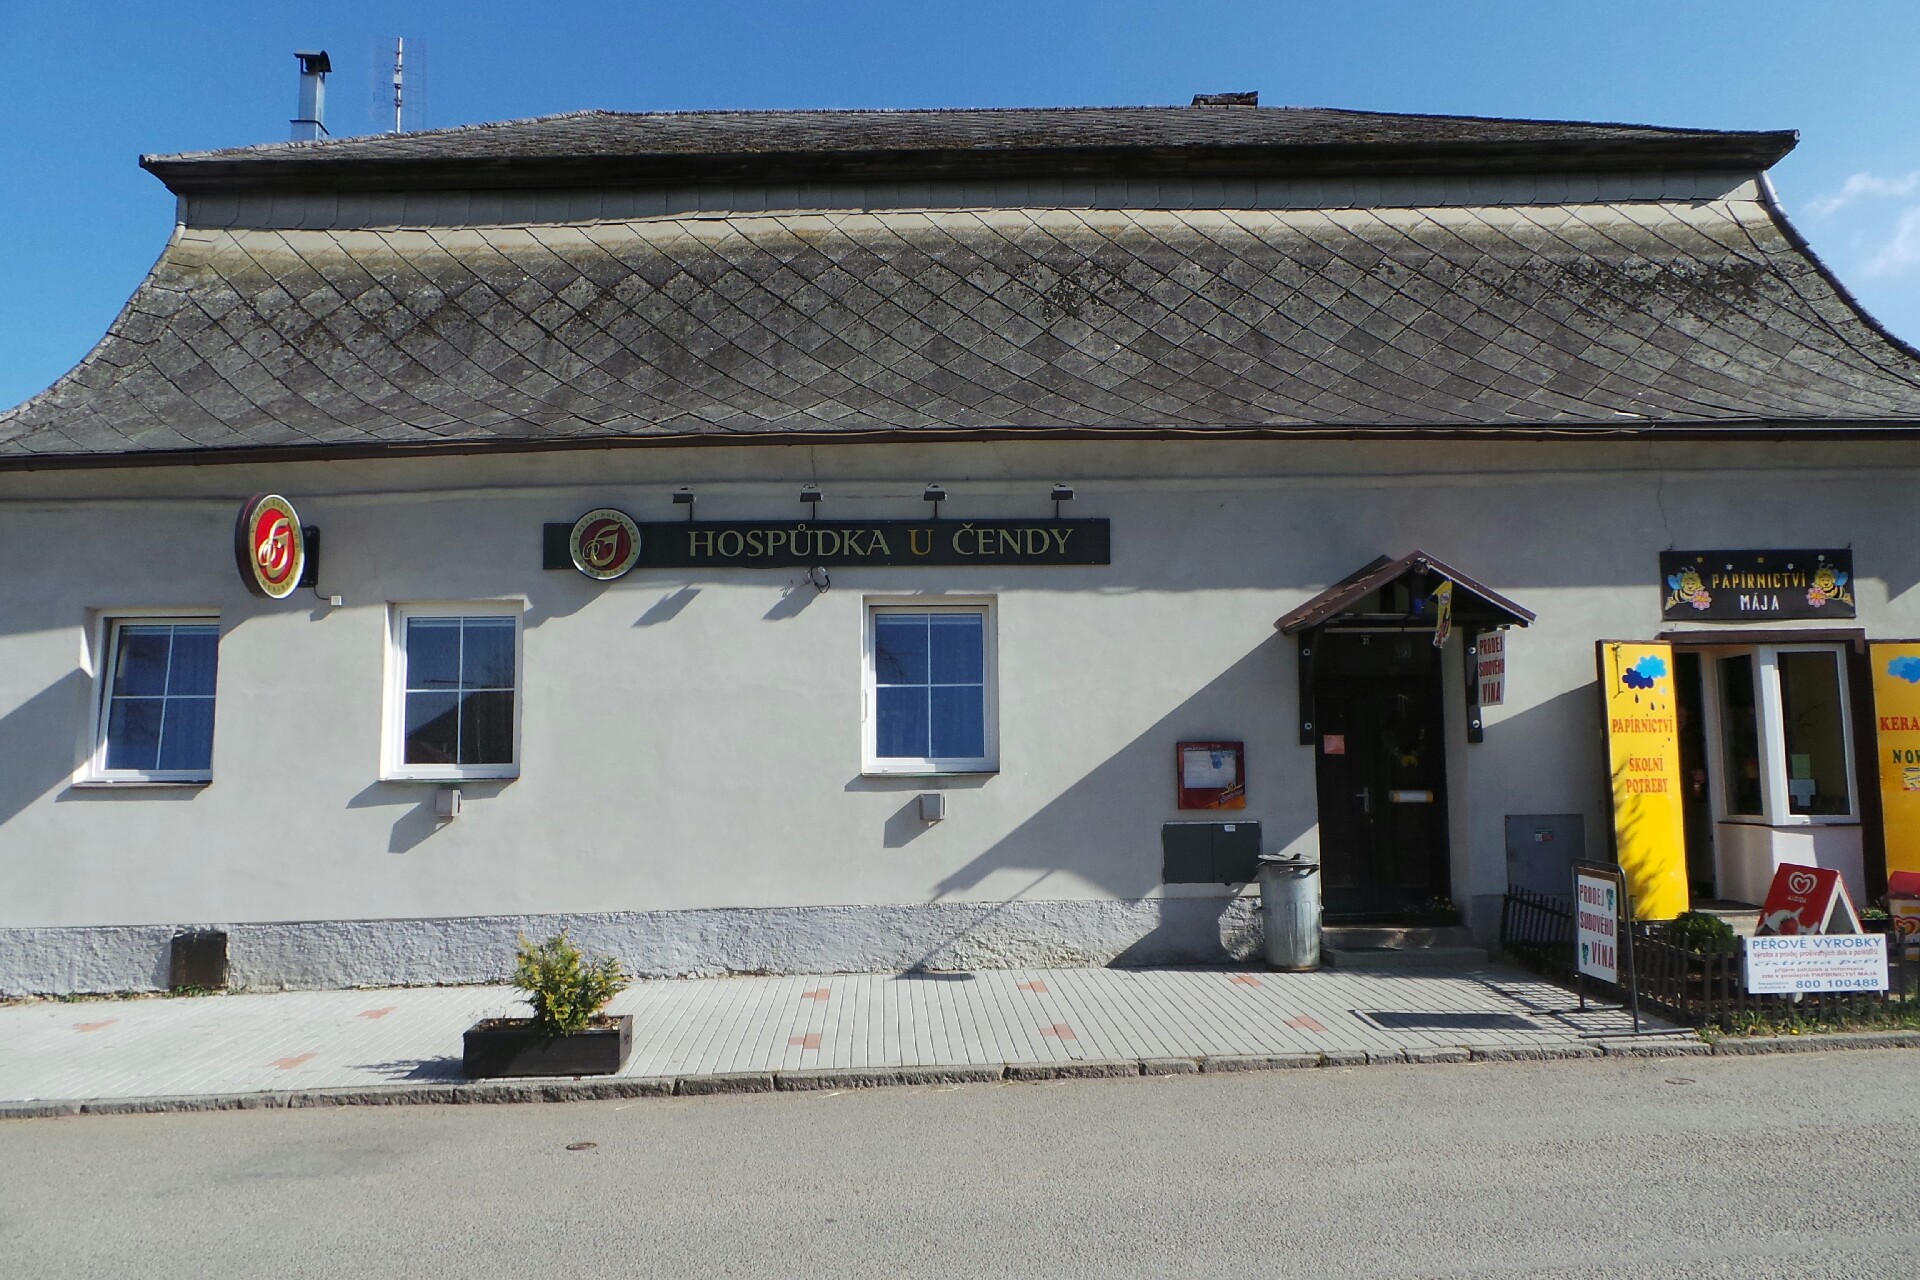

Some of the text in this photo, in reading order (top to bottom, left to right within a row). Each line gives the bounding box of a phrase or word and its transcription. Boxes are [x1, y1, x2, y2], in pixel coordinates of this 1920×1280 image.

[688, 522, 1075, 557] HOSPŮDKA U ČENDY
[1712, 569, 1806, 589] PAPÍRNICTVÍ
[1740, 592, 1780, 611] MÁJA
[1479, 635, 1502, 655] PRODEJ
[1479, 656, 1504, 677] SUDOVÉHO
[1483, 679, 1501, 704] VÍNA
[1612, 714, 1673, 733] PAPÍRNICTVÍ
[1880, 716, 1920, 731] KERA
[1629, 753, 1664, 772] ŠKOLNÍ
[1626, 774, 1668, 794] POTŘEBY
[1580, 884, 1604, 907] PRODEJ
[1580, 911, 1614, 937] SUDOVÉHO
[1752, 936, 1881, 950] PÉŘOVÉ VÝROBKY
[1592, 939, 1615, 970] VÍNA
[1753, 951, 1773, 959] výroba
[1780, 950, 1798, 959] prodej
[1796, 979, 1879, 989] 800 100488
